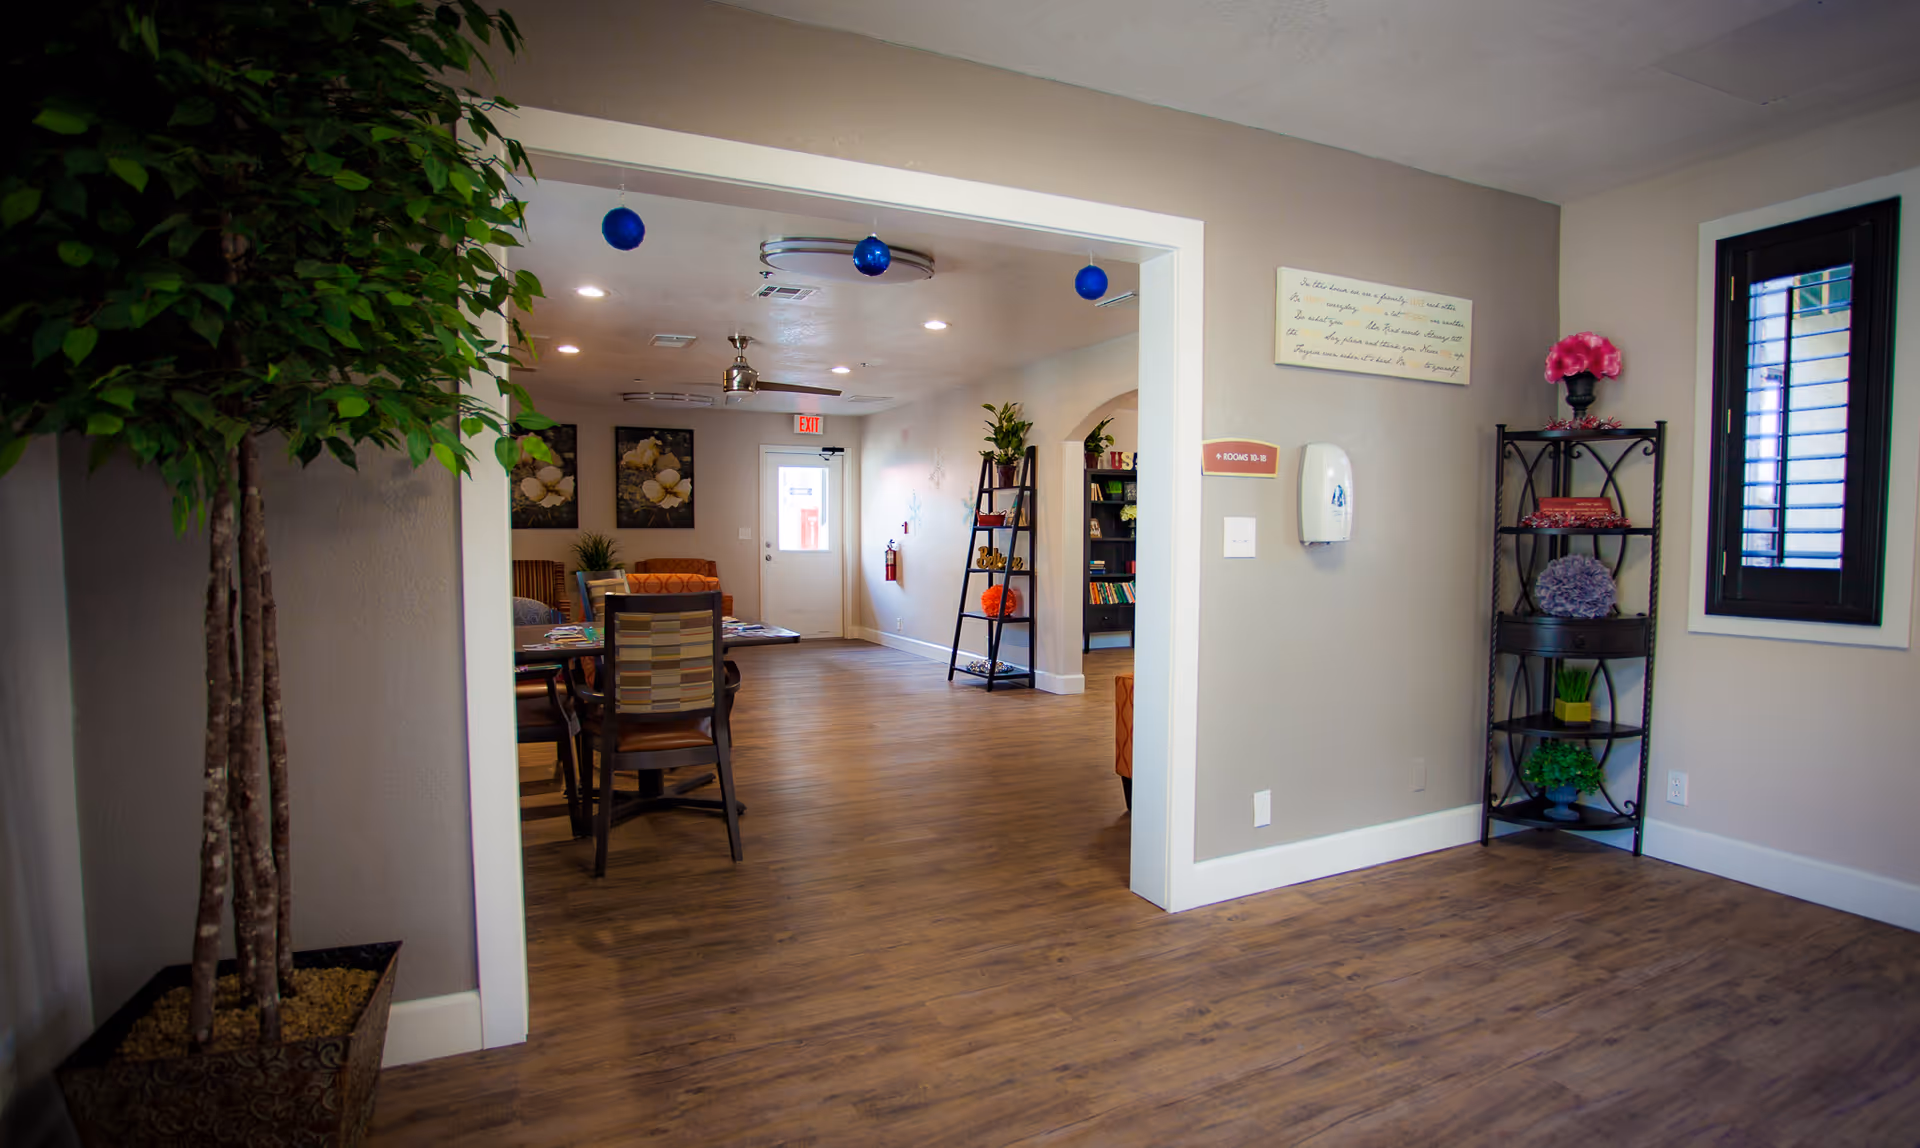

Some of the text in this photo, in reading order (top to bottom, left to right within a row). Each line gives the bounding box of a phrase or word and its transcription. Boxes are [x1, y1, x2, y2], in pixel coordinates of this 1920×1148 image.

[799, 415, 820, 433] EXIT
[1223, 453, 1248, 461] ROOMS
[976, 546, 1023, 571] Beliee
